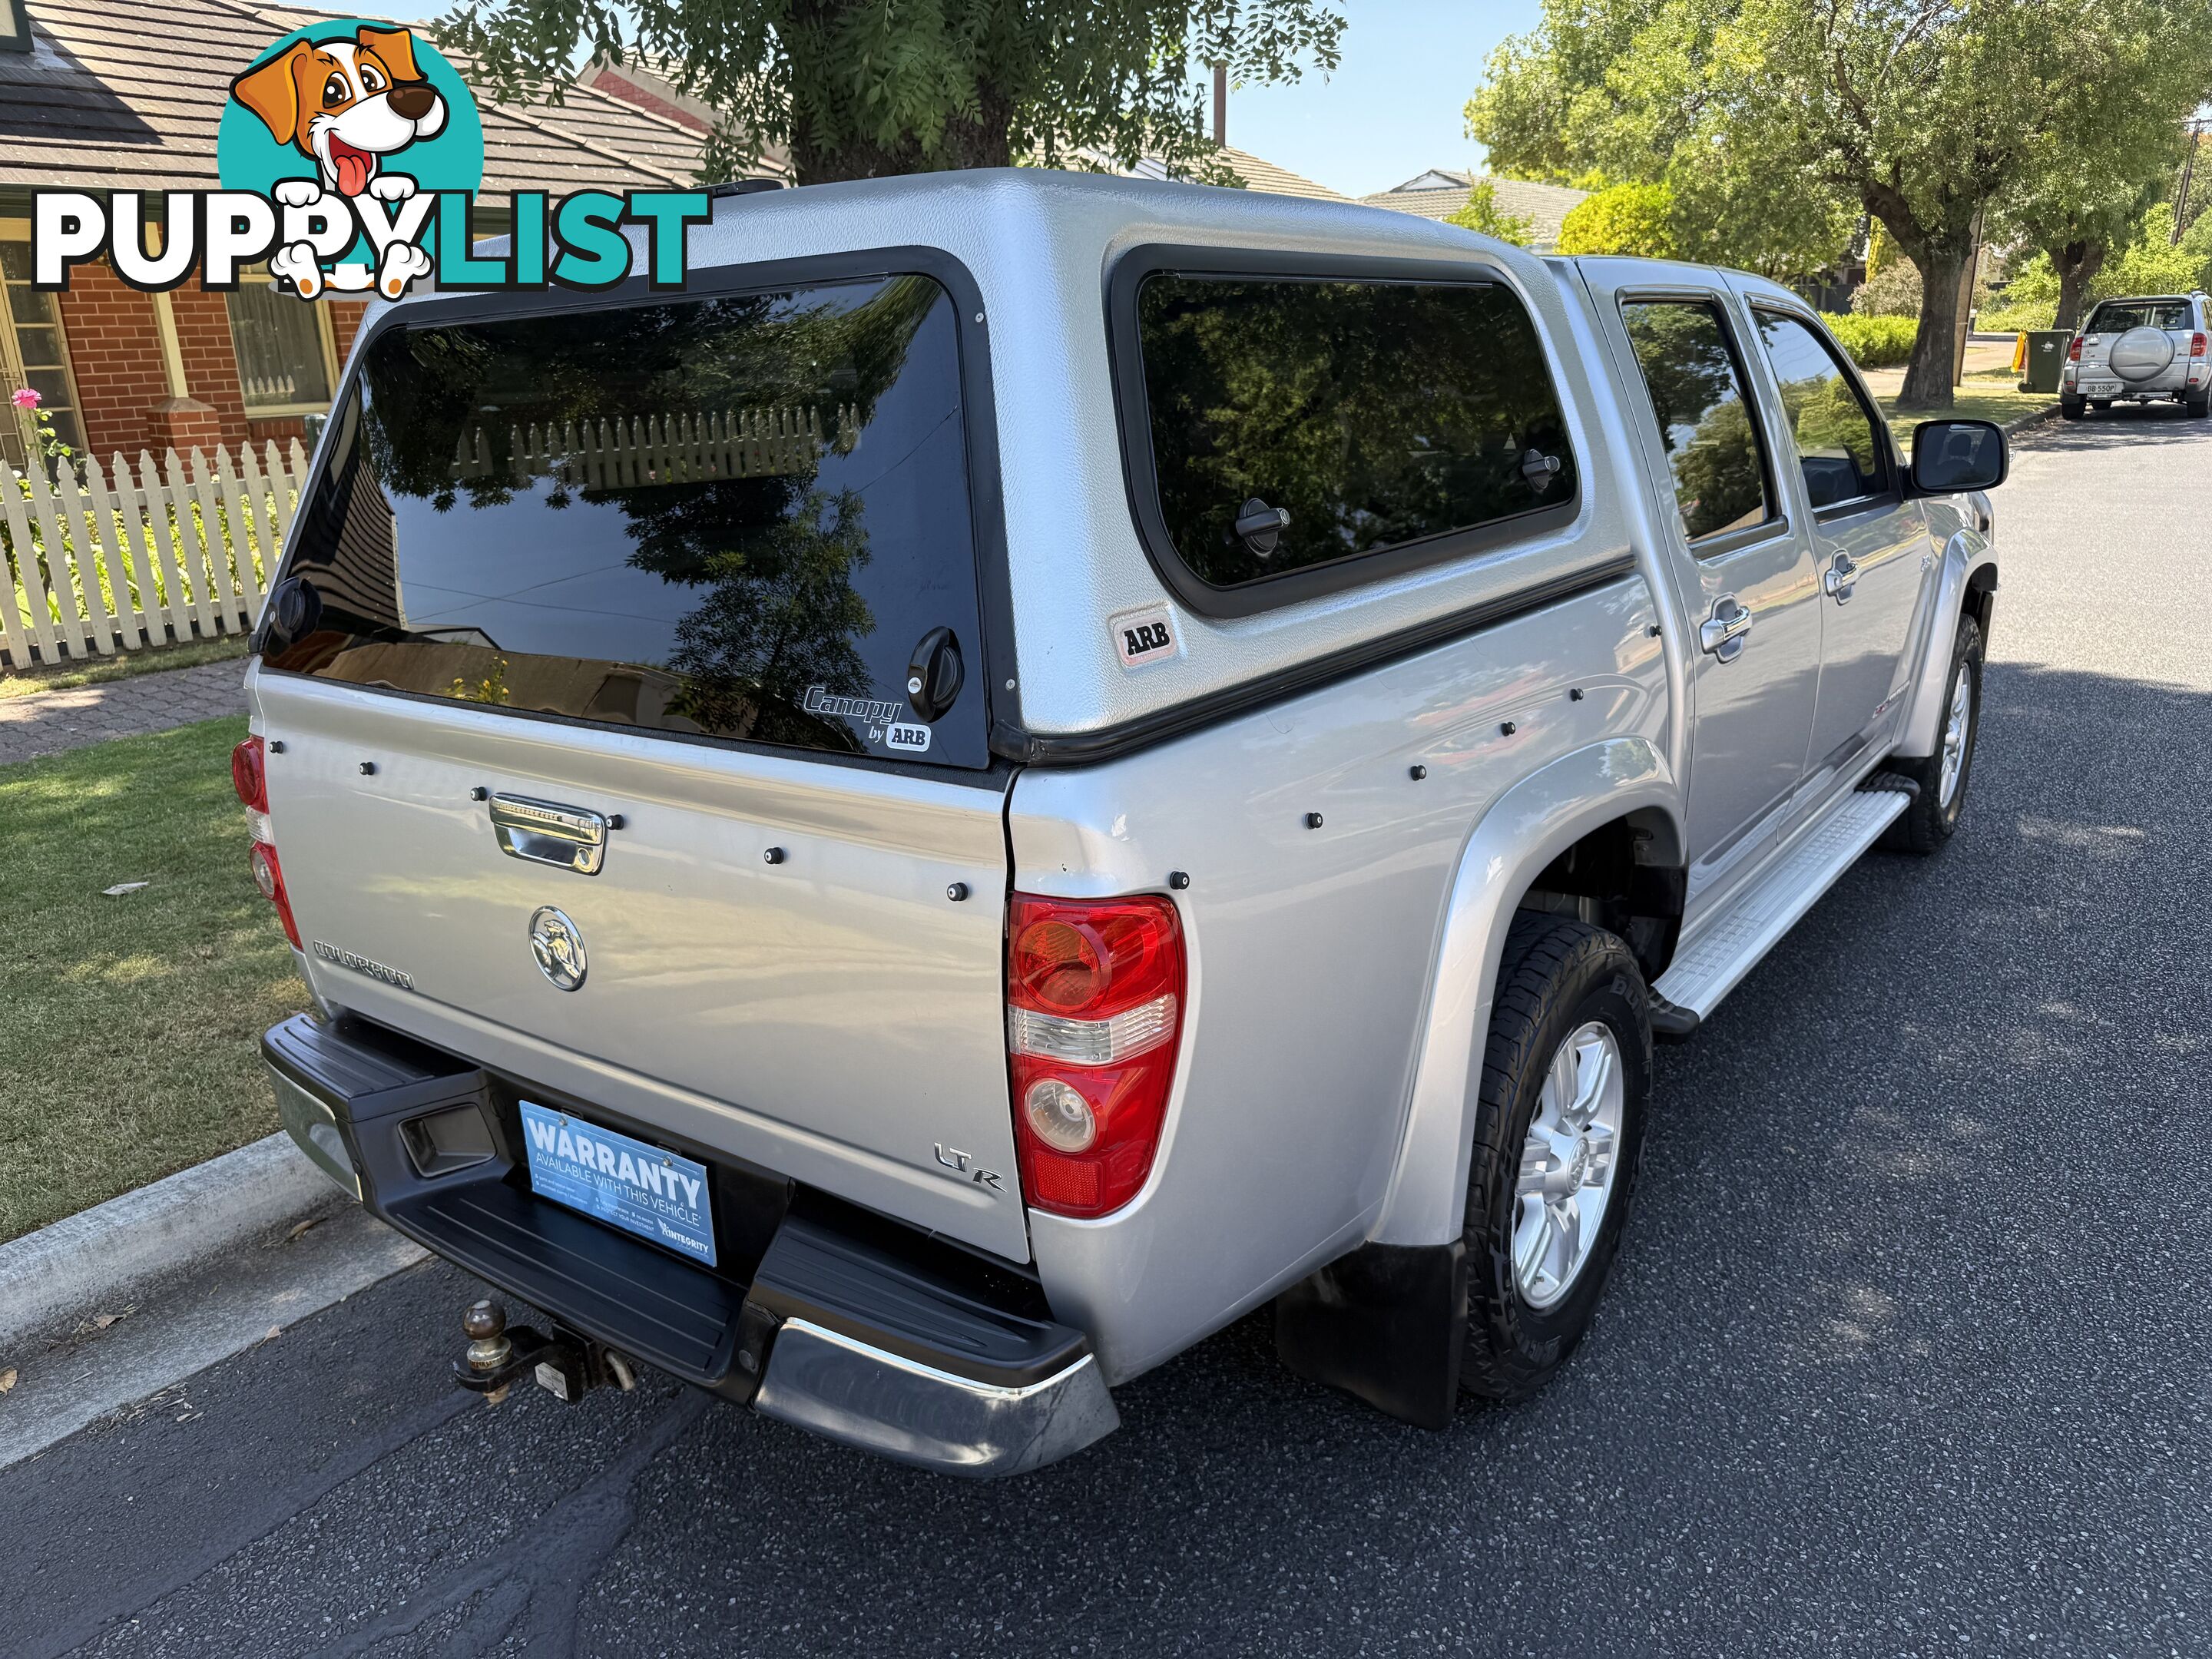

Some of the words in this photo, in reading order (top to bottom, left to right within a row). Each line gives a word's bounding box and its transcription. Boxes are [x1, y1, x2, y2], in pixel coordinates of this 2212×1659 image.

[1124, 622, 1171, 656] ARB
[803, 686, 902, 725] Canopy
[869, 726, 885, 743] by
[891, 727, 926, 746] ARB
[527, 1118, 701, 1210] WARRANTY
[536, 1152, 592, 1184] AVAILABLE
[593, 1175, 622, 1195] WITH
[623, 1184, 649, 1205] THIS
[667, 1229, 709, 1253] INTEGRITY
